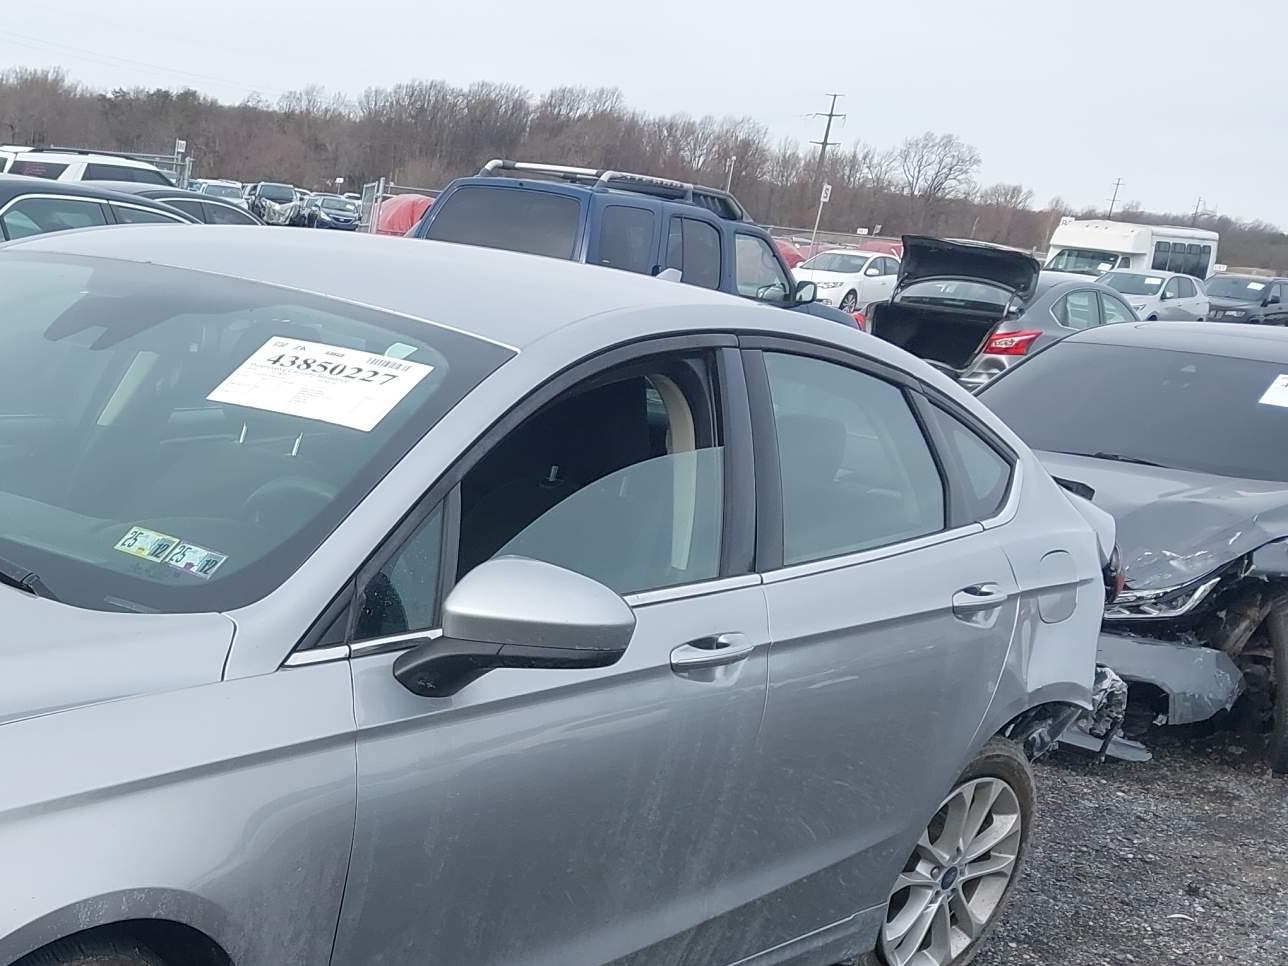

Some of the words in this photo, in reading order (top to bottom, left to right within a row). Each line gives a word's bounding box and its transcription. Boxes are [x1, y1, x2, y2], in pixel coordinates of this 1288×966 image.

[266, 353, 399, 386] 43850227
[120, 530, 144, 548] 25
[152, 543, 170, 559] 12
[169, 545, 192, 563] 25
[197, 559, 218, 575] 12
